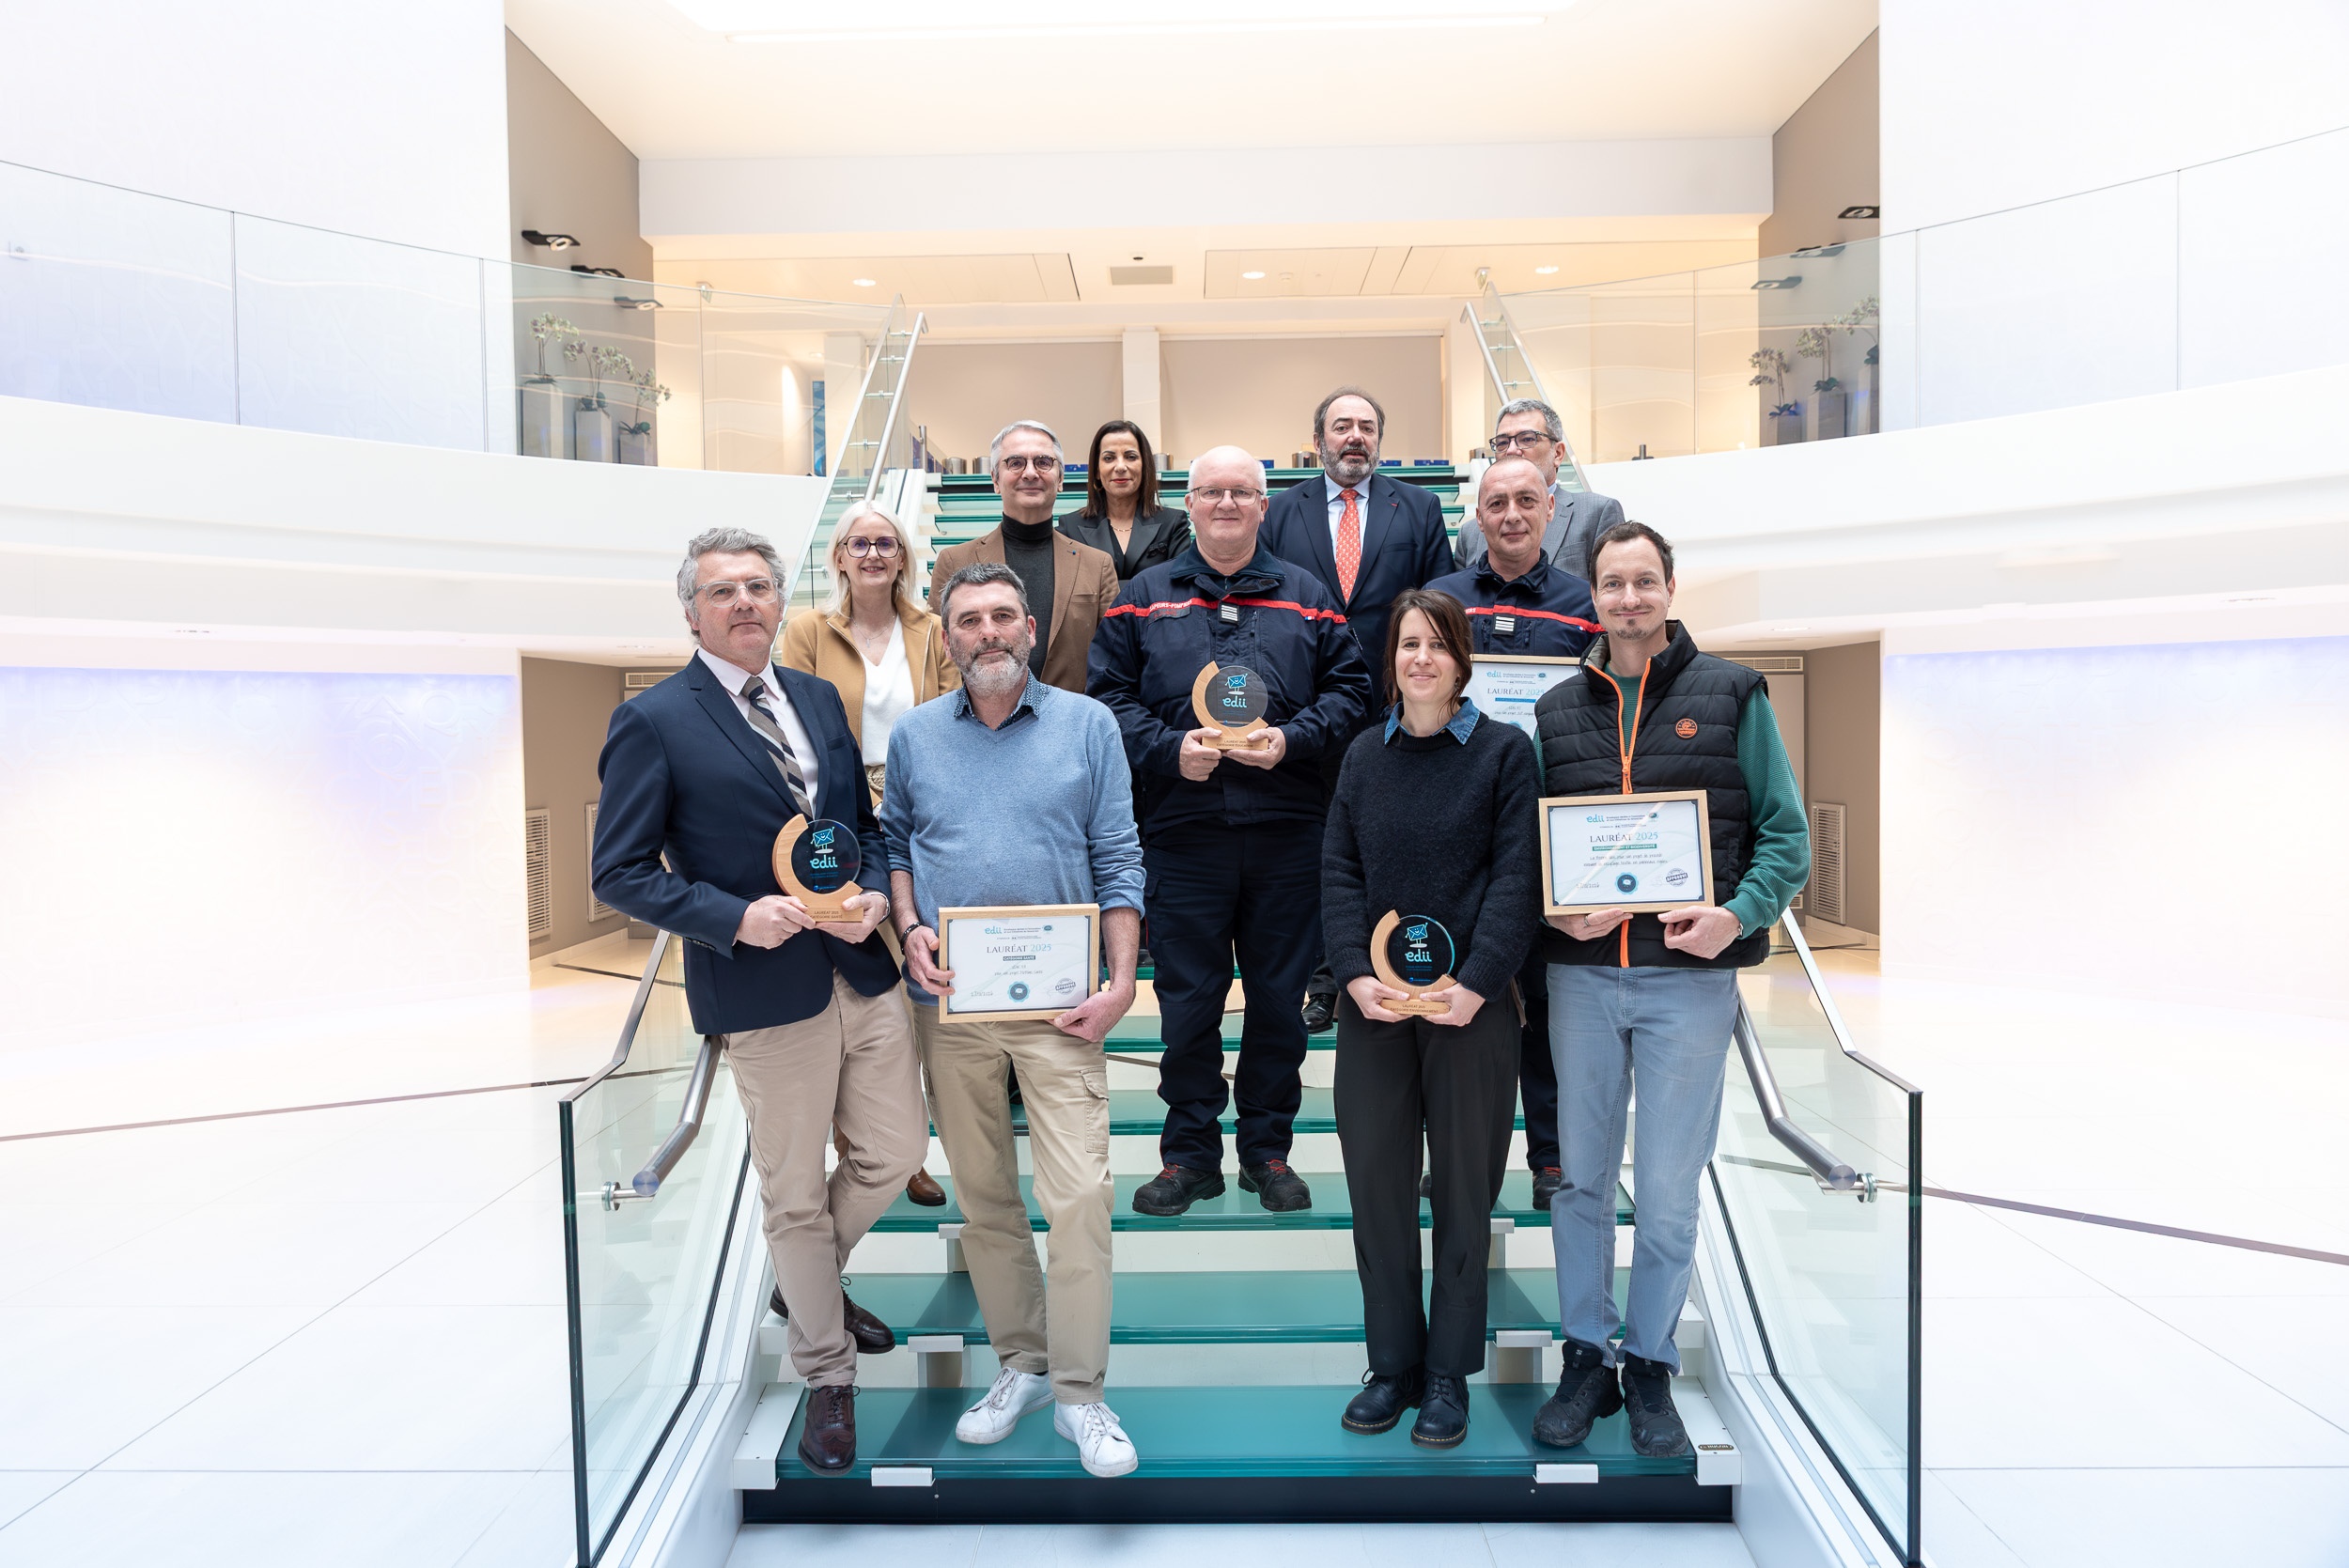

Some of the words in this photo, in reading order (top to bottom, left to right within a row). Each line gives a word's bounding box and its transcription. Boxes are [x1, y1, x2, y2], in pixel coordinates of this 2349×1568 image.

[1486, 670, 1502, 678] edii
[1487, 687, 1523, 695] LAURÉAT
[1222, 695, 1248, 708] edii
[1586, 814, 1605, 823] edii
[1590, 832, 1632, 843] LAURÉAT
[1636, 831, 1658, 841] 2025
[810, 854, 838, 869] edii
[985, 925, 1003, 935] edii
[987, 943, 1028, 954] LAURÉAT
[1031, 943, 1051, 953] 2025
[1405, 948, 1432, 963] edii
